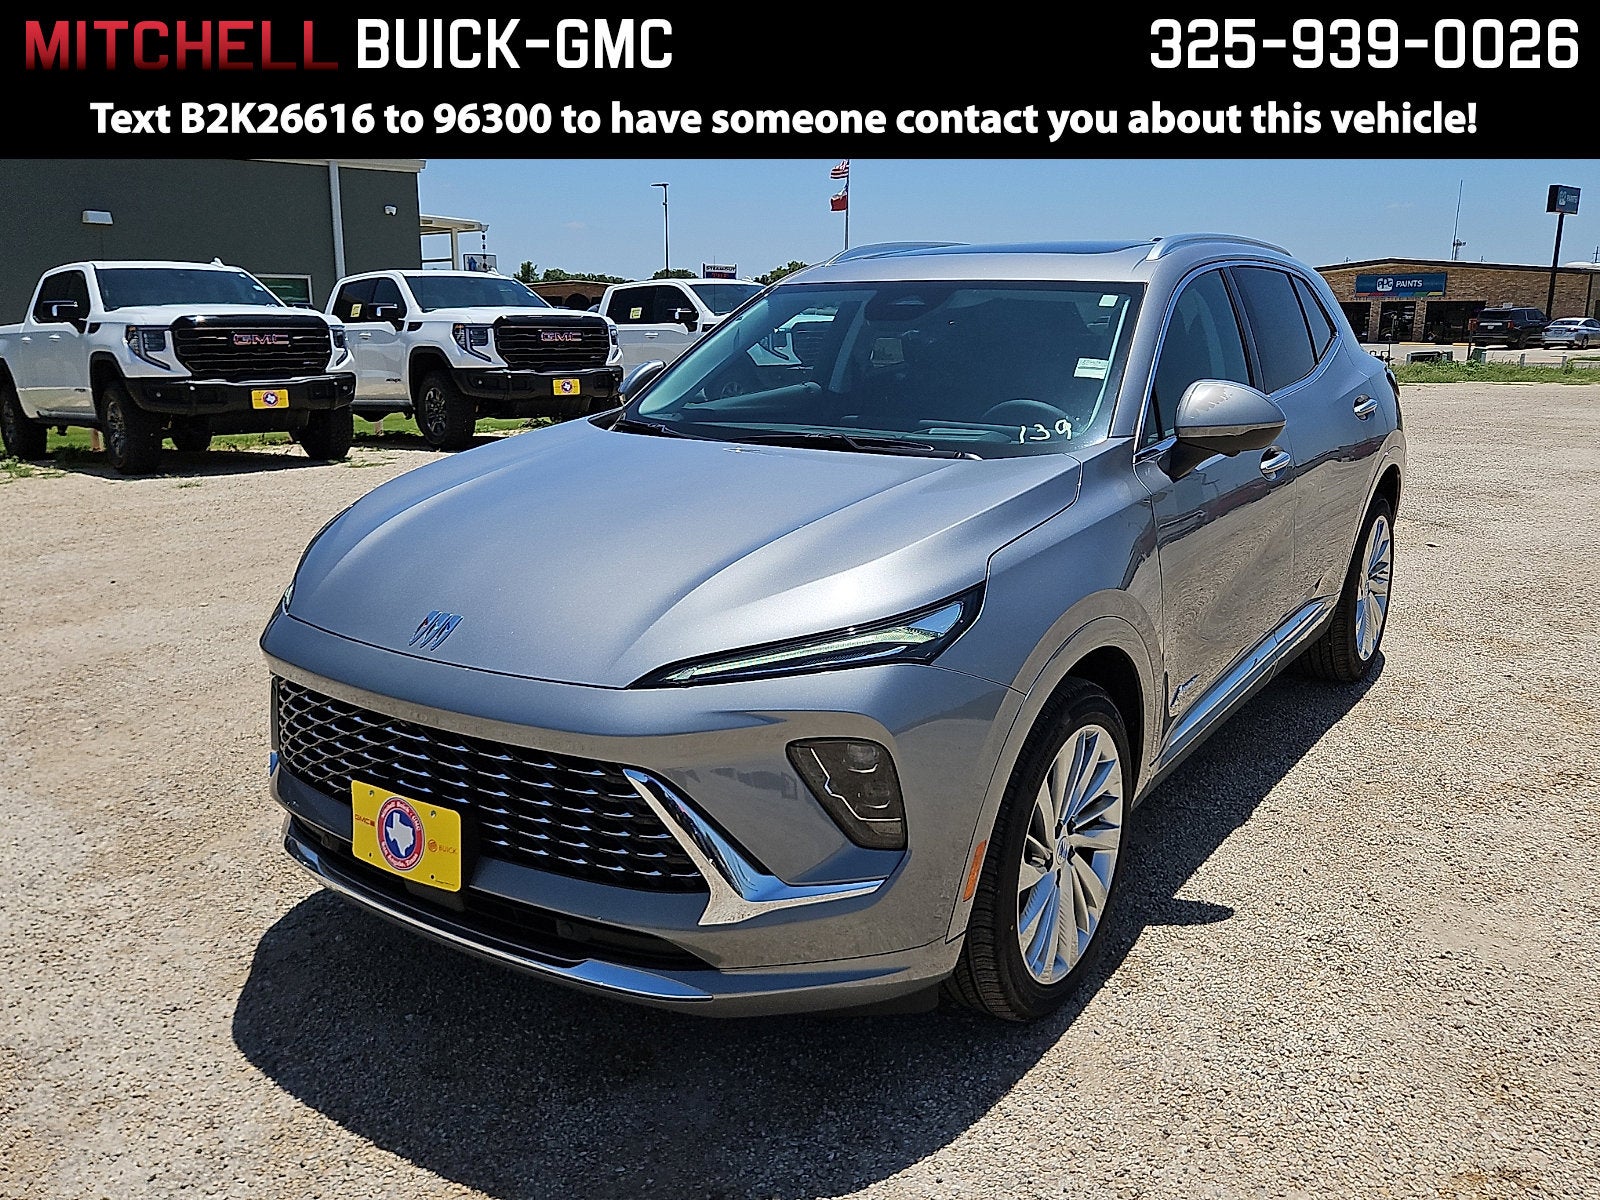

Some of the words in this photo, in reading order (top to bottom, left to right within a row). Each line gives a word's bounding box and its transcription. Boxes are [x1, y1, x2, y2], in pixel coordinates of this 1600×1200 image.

[1377, 278, 1394, 291] PPG
[1395, 280, 1423, 288] PAINTS
[233, 333, 290, 345] GMC
[540, 331, 582, 341] GMC
[1017, 418, 1073, 445] 139
